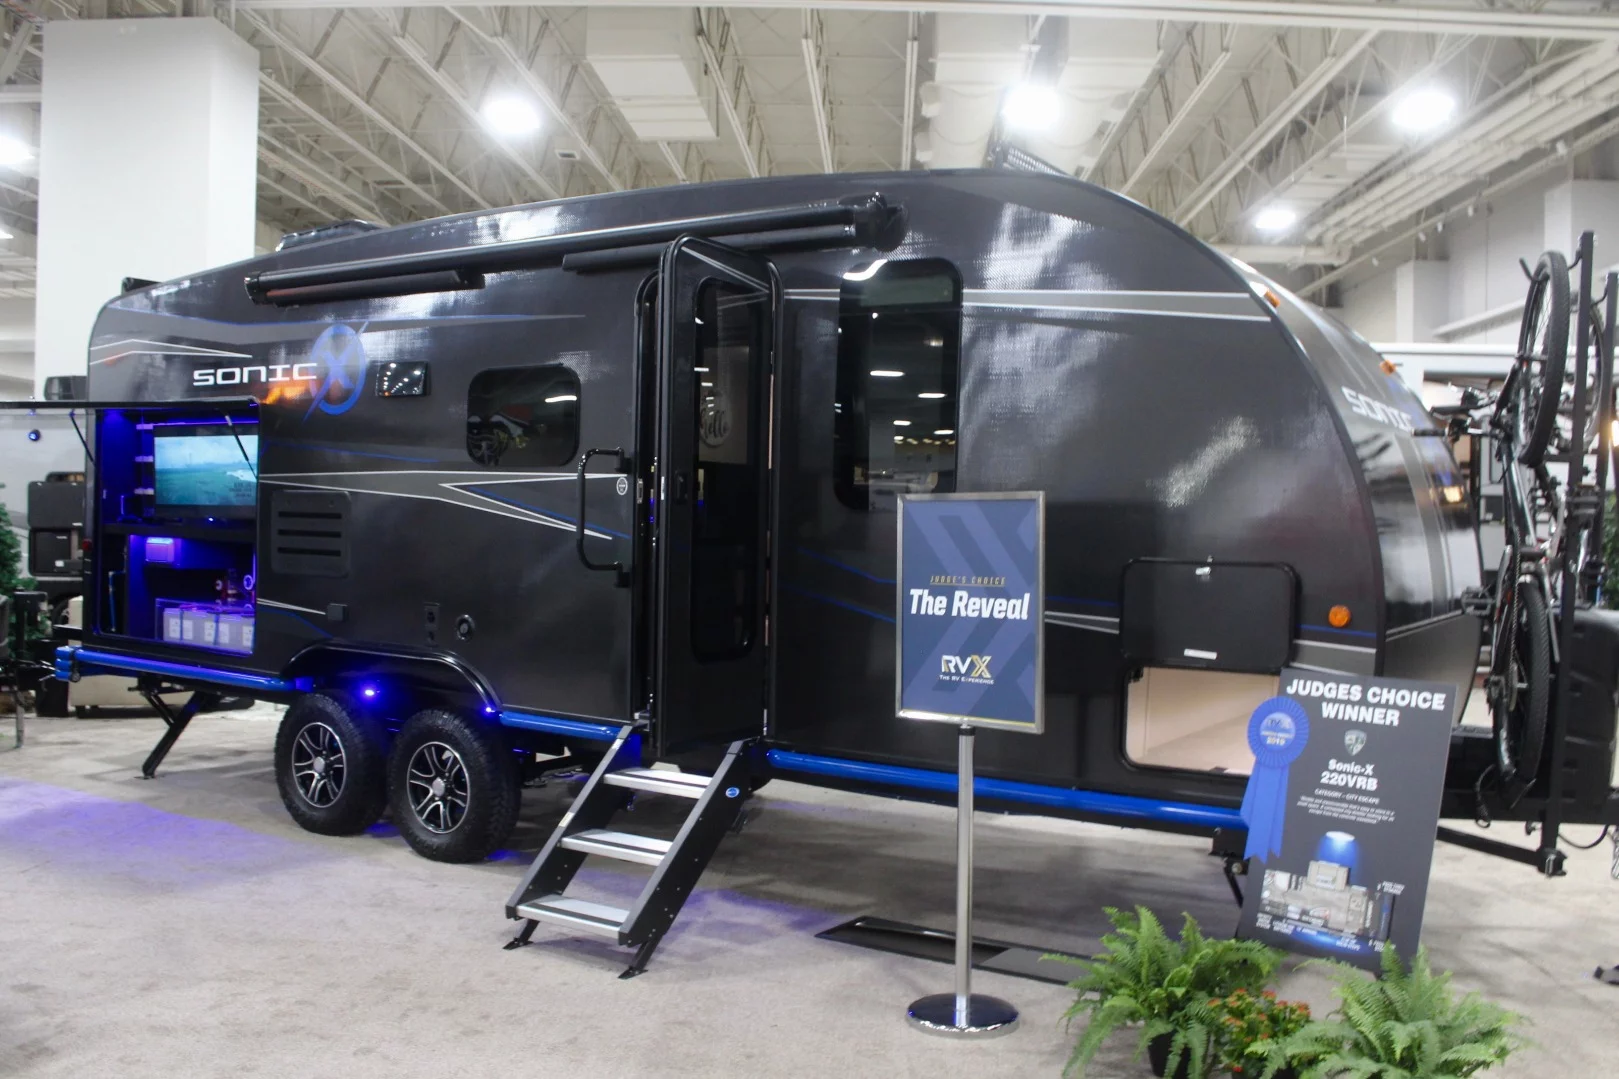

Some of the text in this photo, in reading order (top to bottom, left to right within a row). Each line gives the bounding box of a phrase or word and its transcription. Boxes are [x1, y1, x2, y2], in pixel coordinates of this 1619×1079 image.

[193, 362, 317, 386] SONIC
[971, 576, 1006, 585] CHOICE
[910, 588, 1031, 621] The Reveal
[941, 654, 992, 678] RVX
[1286, 678, 1447, 711] JUDGES CHOICE
[1321, 701, 1400, 727] WINNER
[1328, 758, 1375, 776] Sonic-X
[1320, 771, 1379, 792] 220VRB
